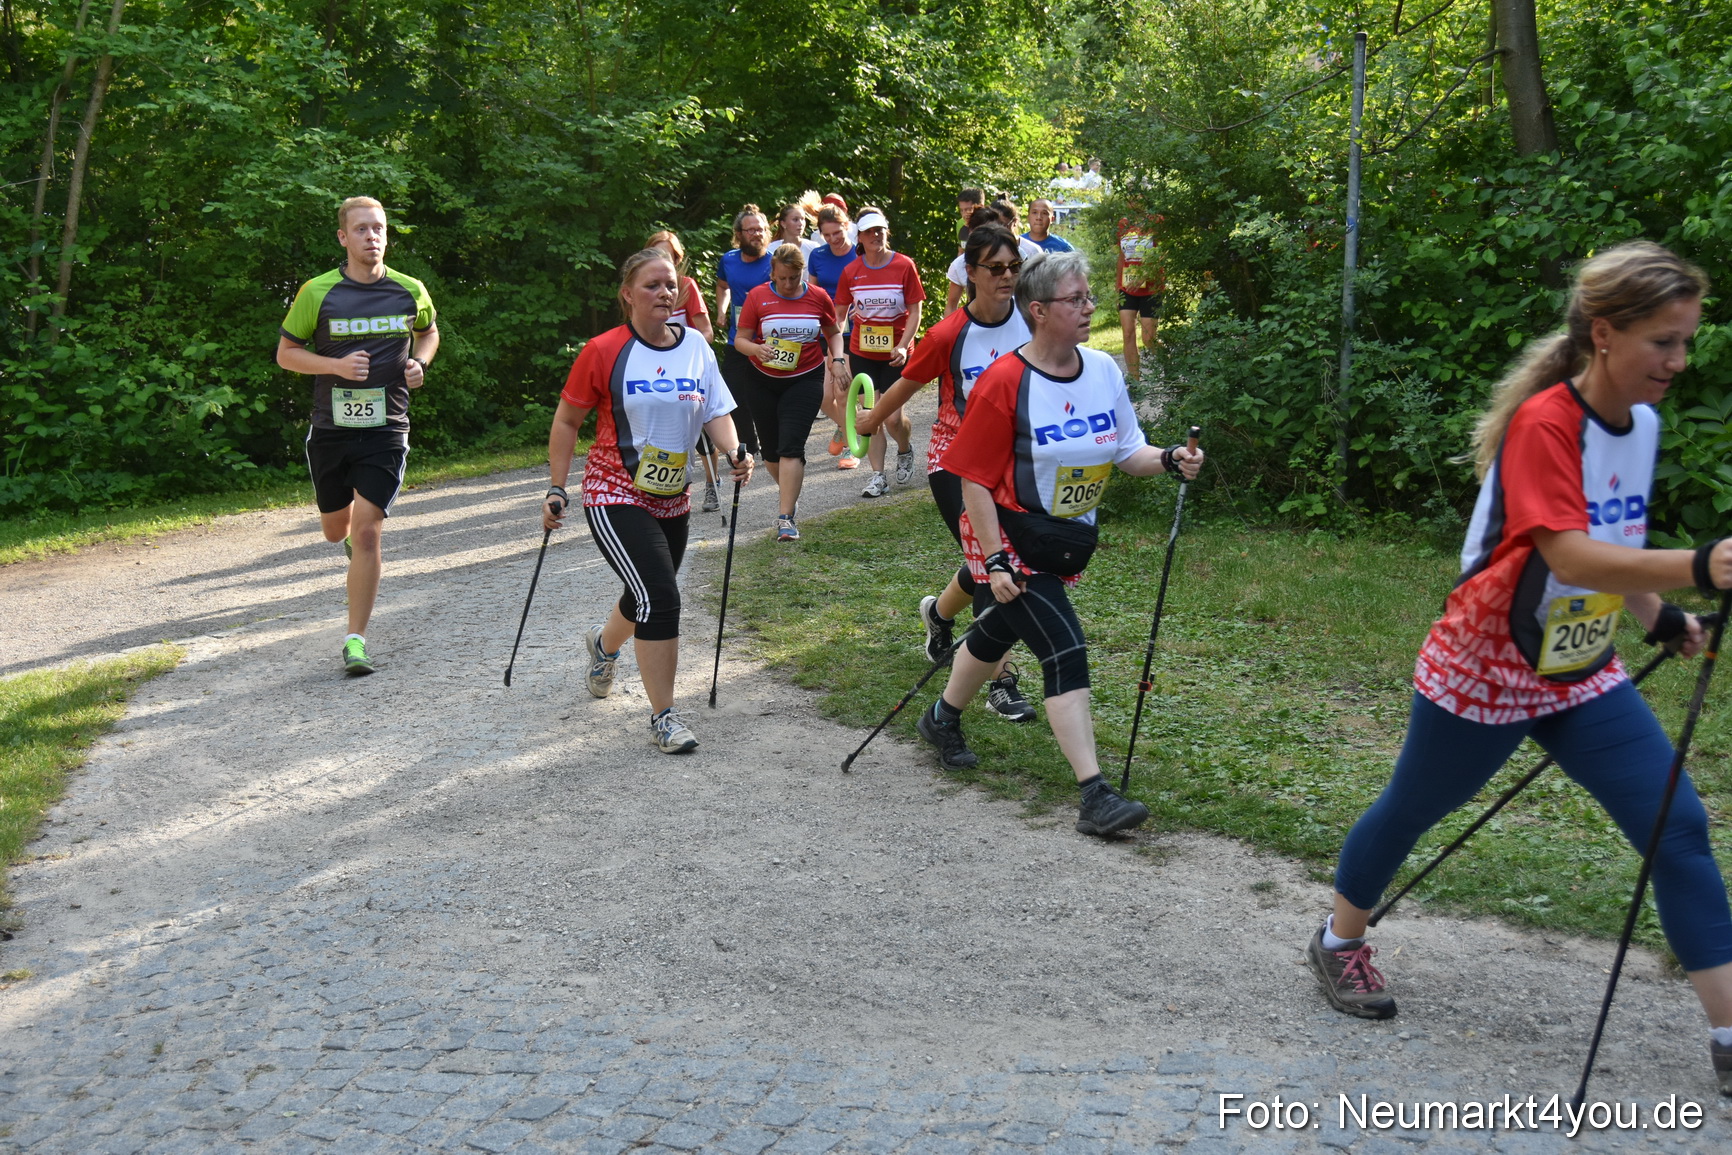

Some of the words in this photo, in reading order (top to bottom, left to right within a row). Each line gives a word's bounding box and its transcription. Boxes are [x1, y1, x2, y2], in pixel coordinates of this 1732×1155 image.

[865, 298, 897, 306] Petry
[330, 315, 409, 335] BOCK
[780, 327, 814, 335] Petry
[863, 334, 889, 345] 1819
[774, 349, 795, 363] 828
[343, 402, 375, 417] 325
[644, 463, 685, 483] 2072
[1060, 480, 1104, 505] 2066
[1552, 613, 1613, 652] 2064
